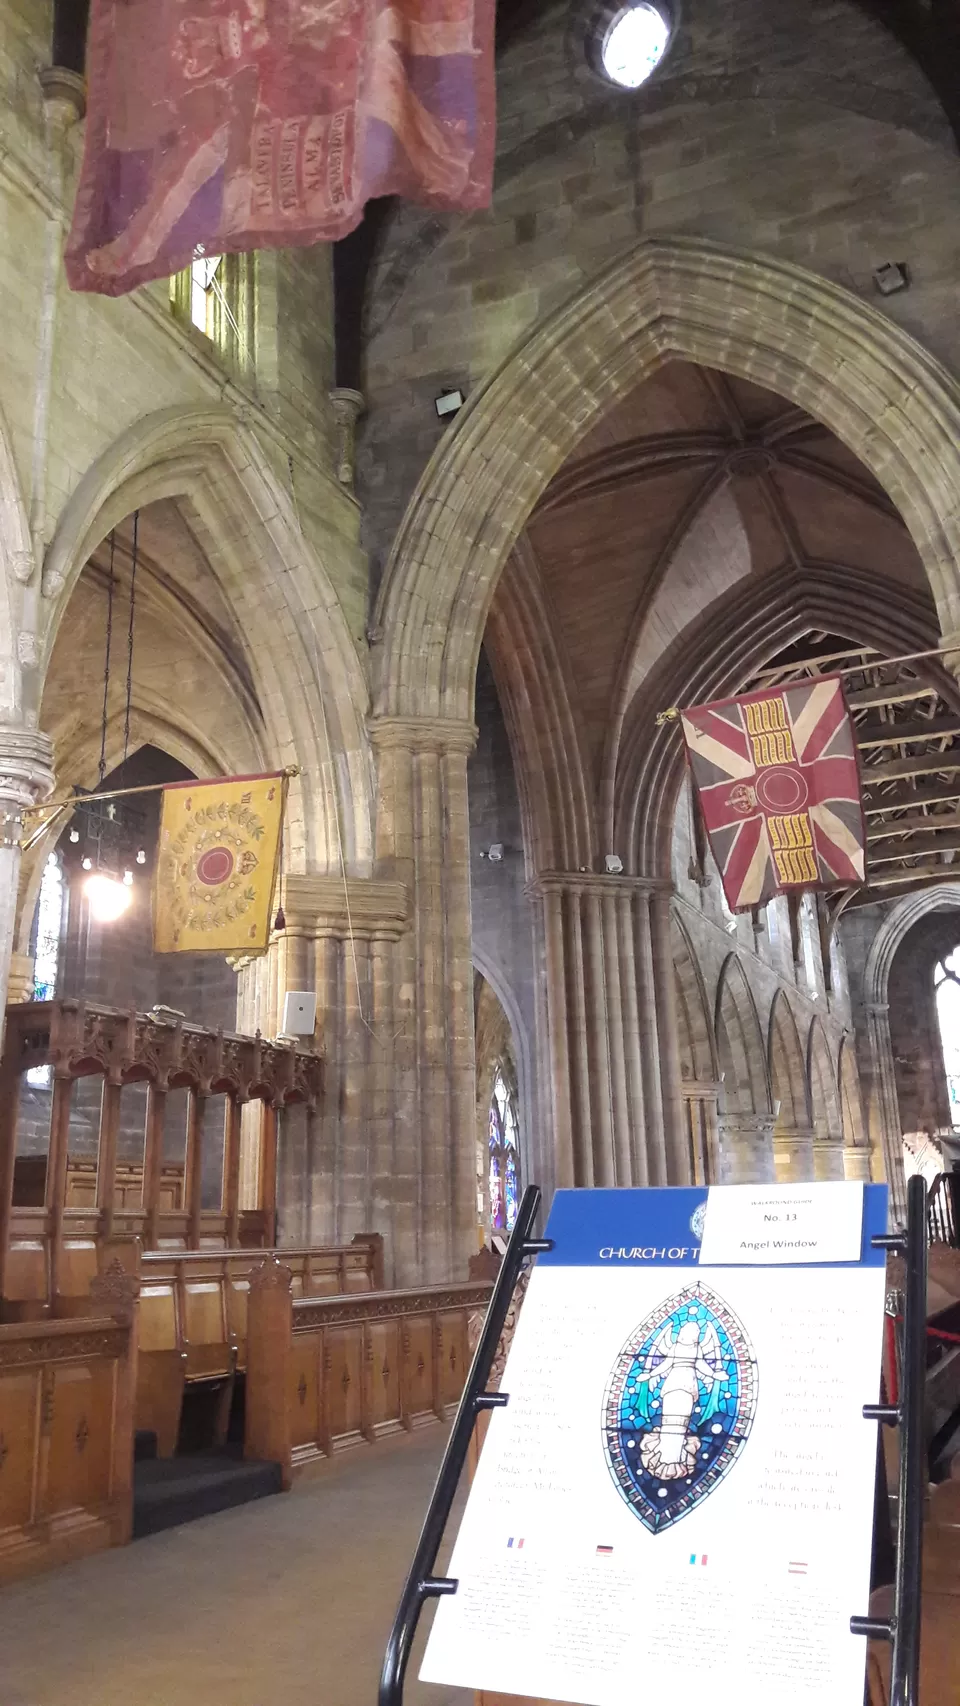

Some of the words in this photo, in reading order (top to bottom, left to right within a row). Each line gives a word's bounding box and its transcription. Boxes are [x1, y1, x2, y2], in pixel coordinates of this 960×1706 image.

[304, 136, 321, 192] ALMA
[763, 1214, 781, 1222] No.
[785, 1213, 797, 1221] 13
[740, 1240, 770, 1250] Angel
[772, 1239, 818, 1248] Window
[599, 1247, 666, 1259] CHURCH
[667, 1247, 690, 1259] OF
